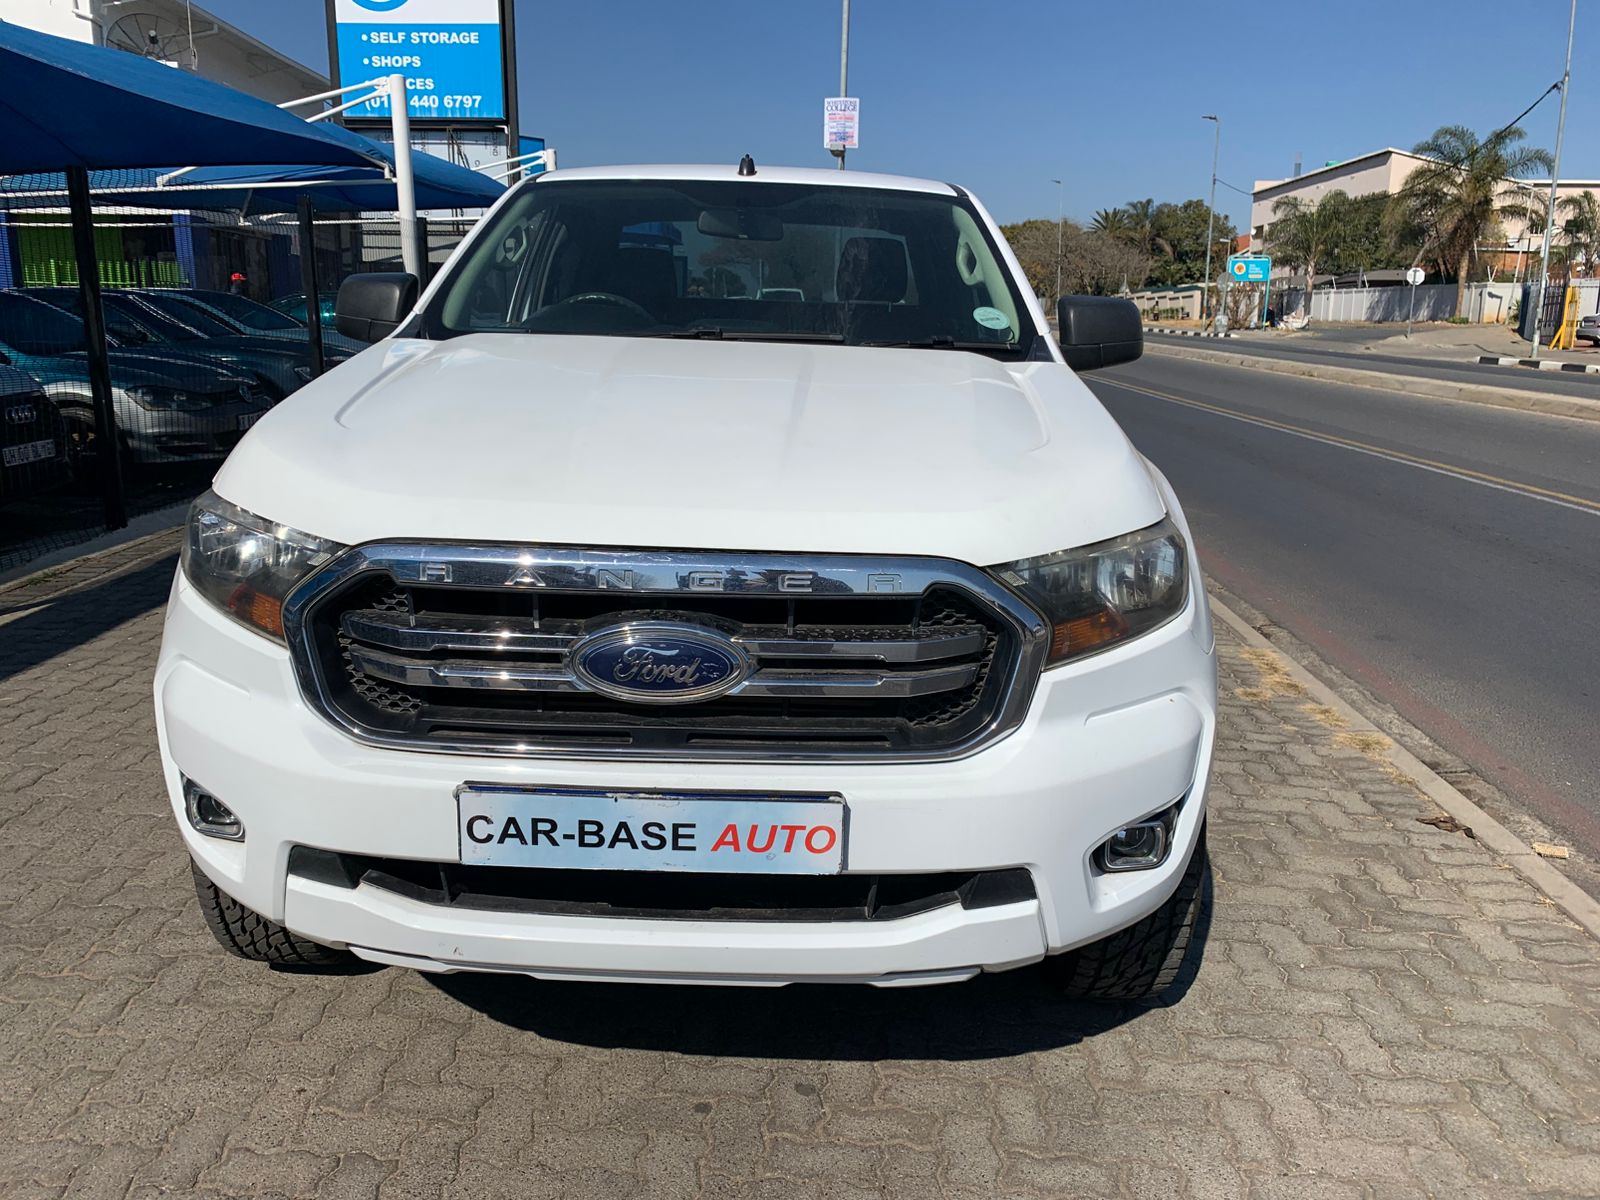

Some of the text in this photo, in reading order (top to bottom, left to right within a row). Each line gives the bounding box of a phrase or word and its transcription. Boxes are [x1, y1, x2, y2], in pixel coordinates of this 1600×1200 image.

[370, 32, 480, 44] SELF STORAGE
[371, 55, 422, 68] SHOPS
[410, 95, 439, 108] 440
[443, 95, 482, 109] 6797
[418, 561, 903, 594] RANGER
[613, 645, 701, 684] Ford
[465, 814, 837, 855] CAR-BASE AUTO
